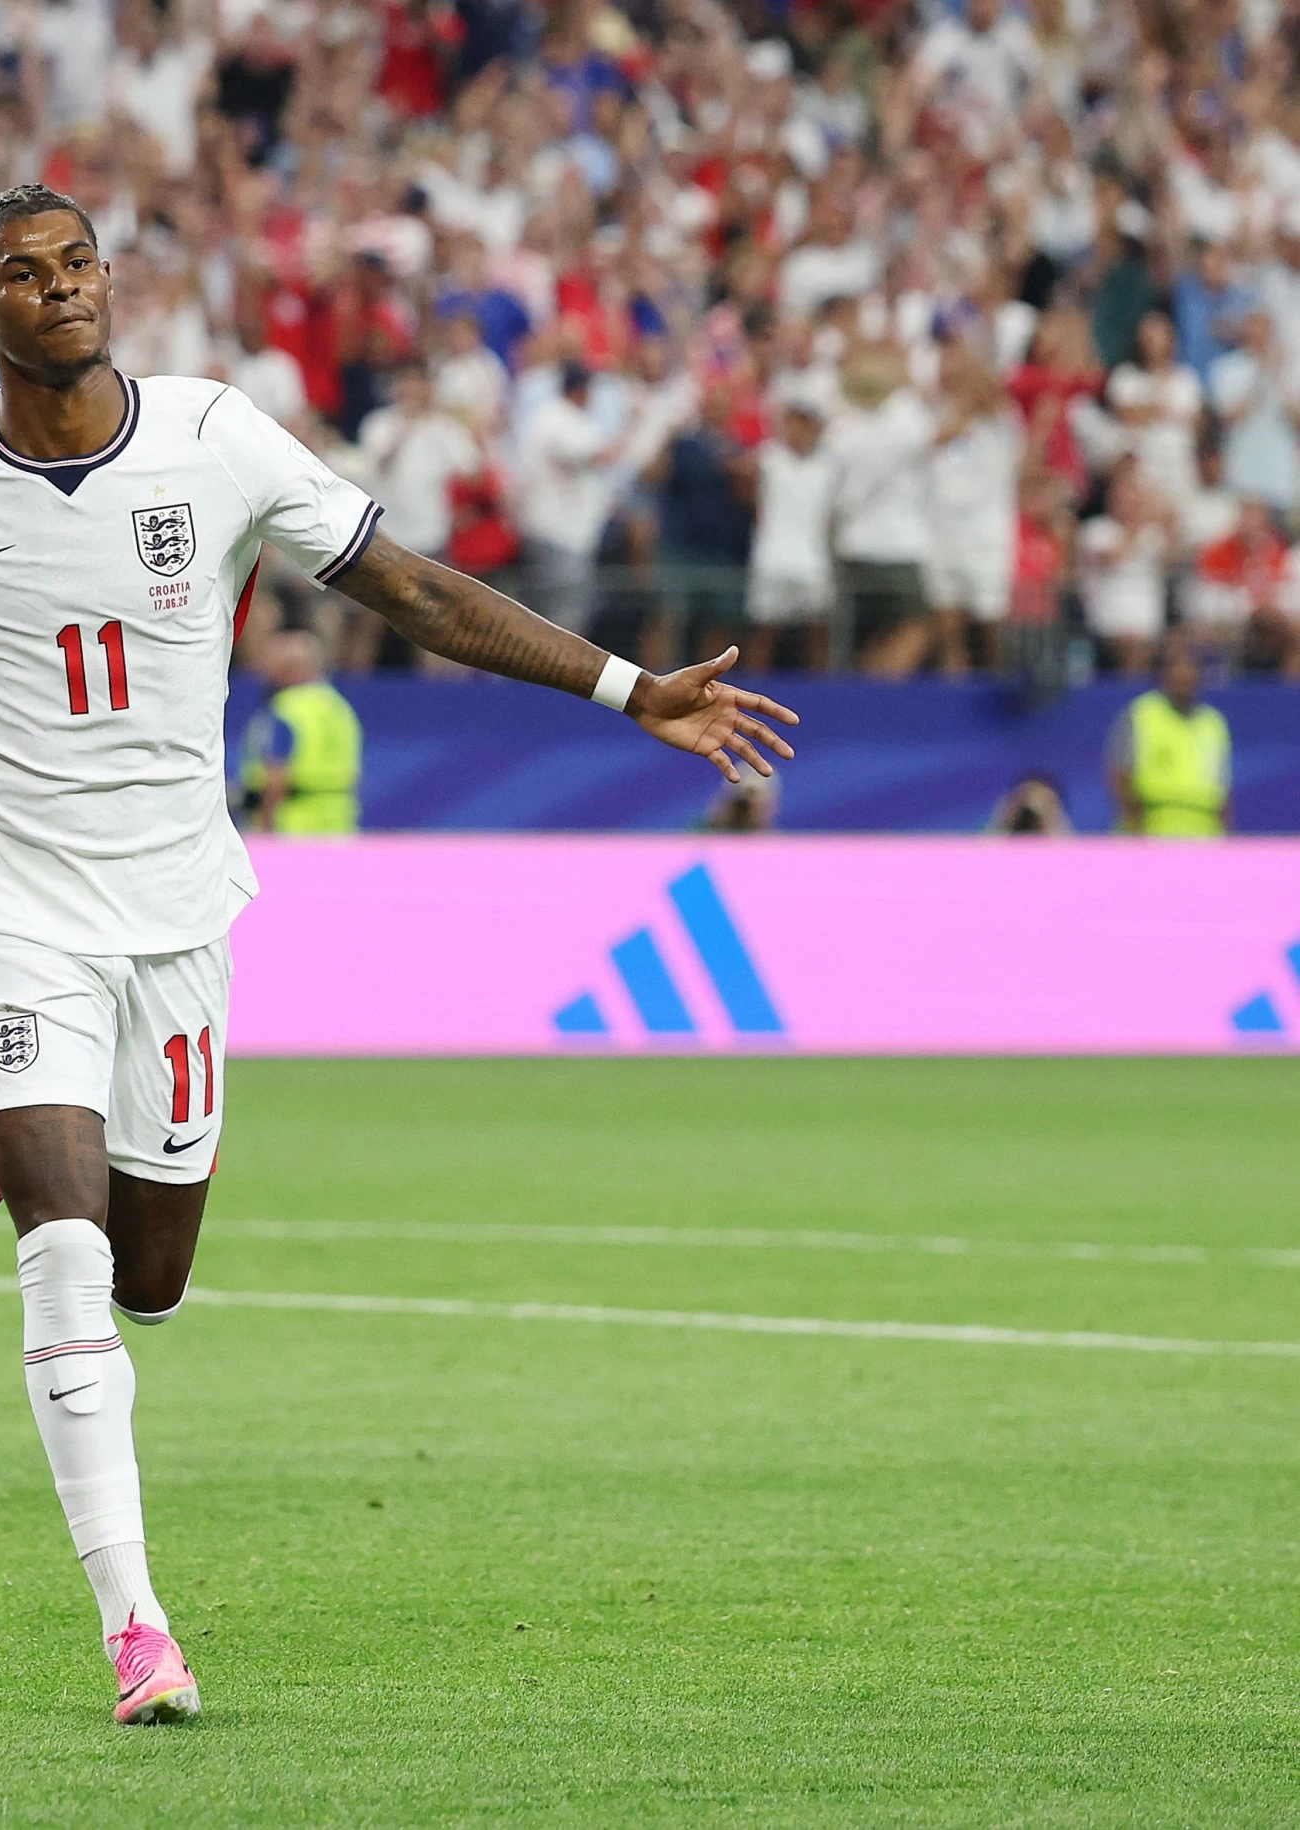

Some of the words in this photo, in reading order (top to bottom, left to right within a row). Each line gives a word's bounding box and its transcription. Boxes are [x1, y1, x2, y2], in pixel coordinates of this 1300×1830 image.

[149, 582, 191, 597] CROATIA
[154, 596, 188, 611] 17.06.26
[57, 621, 129, 715] 11
[164, 1025, 213, 1123] 11
